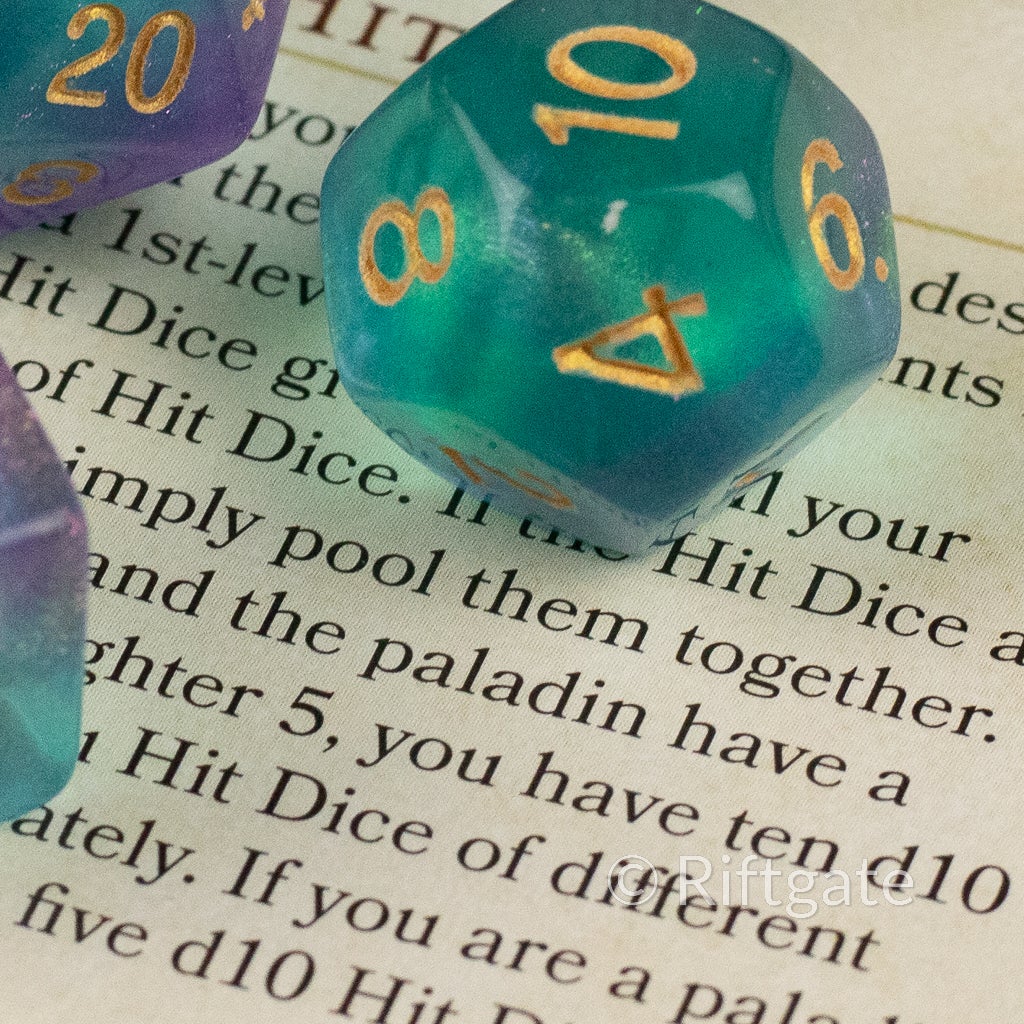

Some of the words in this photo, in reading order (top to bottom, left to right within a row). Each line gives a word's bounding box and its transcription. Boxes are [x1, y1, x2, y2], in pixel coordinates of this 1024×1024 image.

[46, 3, 196, 115] 20
[248, 99, 358, 148] yo
[533, 25, 697, 146] 10
[358, 185, 456, 307] 8
[552, 284, 708, 397] 4
[877, 356, 1005, 408] nts
[10, 358, 94, 404] of
[91, 369, 215, 444] Hit
[225, 409, 410, 505] Dice.
[652, 531, 779, 600] Hit
[791, 563, 969, 648] Dice
[88, 282, 259, 372] Dice
[786, 494, 972, 563] your
[229, 589, 346, 655] the
[357, 638, 647, 739] paladin
[667, 703, 847, 787] have
[868, 771, 910, 807] a
[268, 526, 446, 597] pool
[461, 568, 650, 654] them
[675, 625, 996, 743] together.
[115, 726, 244, 804] Hit
[256, 766, 434, 855] Dice
[457, 835, 547, 882] of
[550, 851, 881, 973] different
[278, 686, 339, 753] 5,
[356, 723, 503, 787] you
[519, 751, 700, 837] have
[724, 810, 840, 874] ten
[866, 844, 1011, 915] d10
[11, 804, 196, 886] ately.
[221, 846, 304, 907] If
[292, 883, 440, 949] you
[460, 927, 588, 985] are
[608, 965, 652, 1004] a
[12, 881, 149, 959] five
[170, 929, 316, 1002] d10
